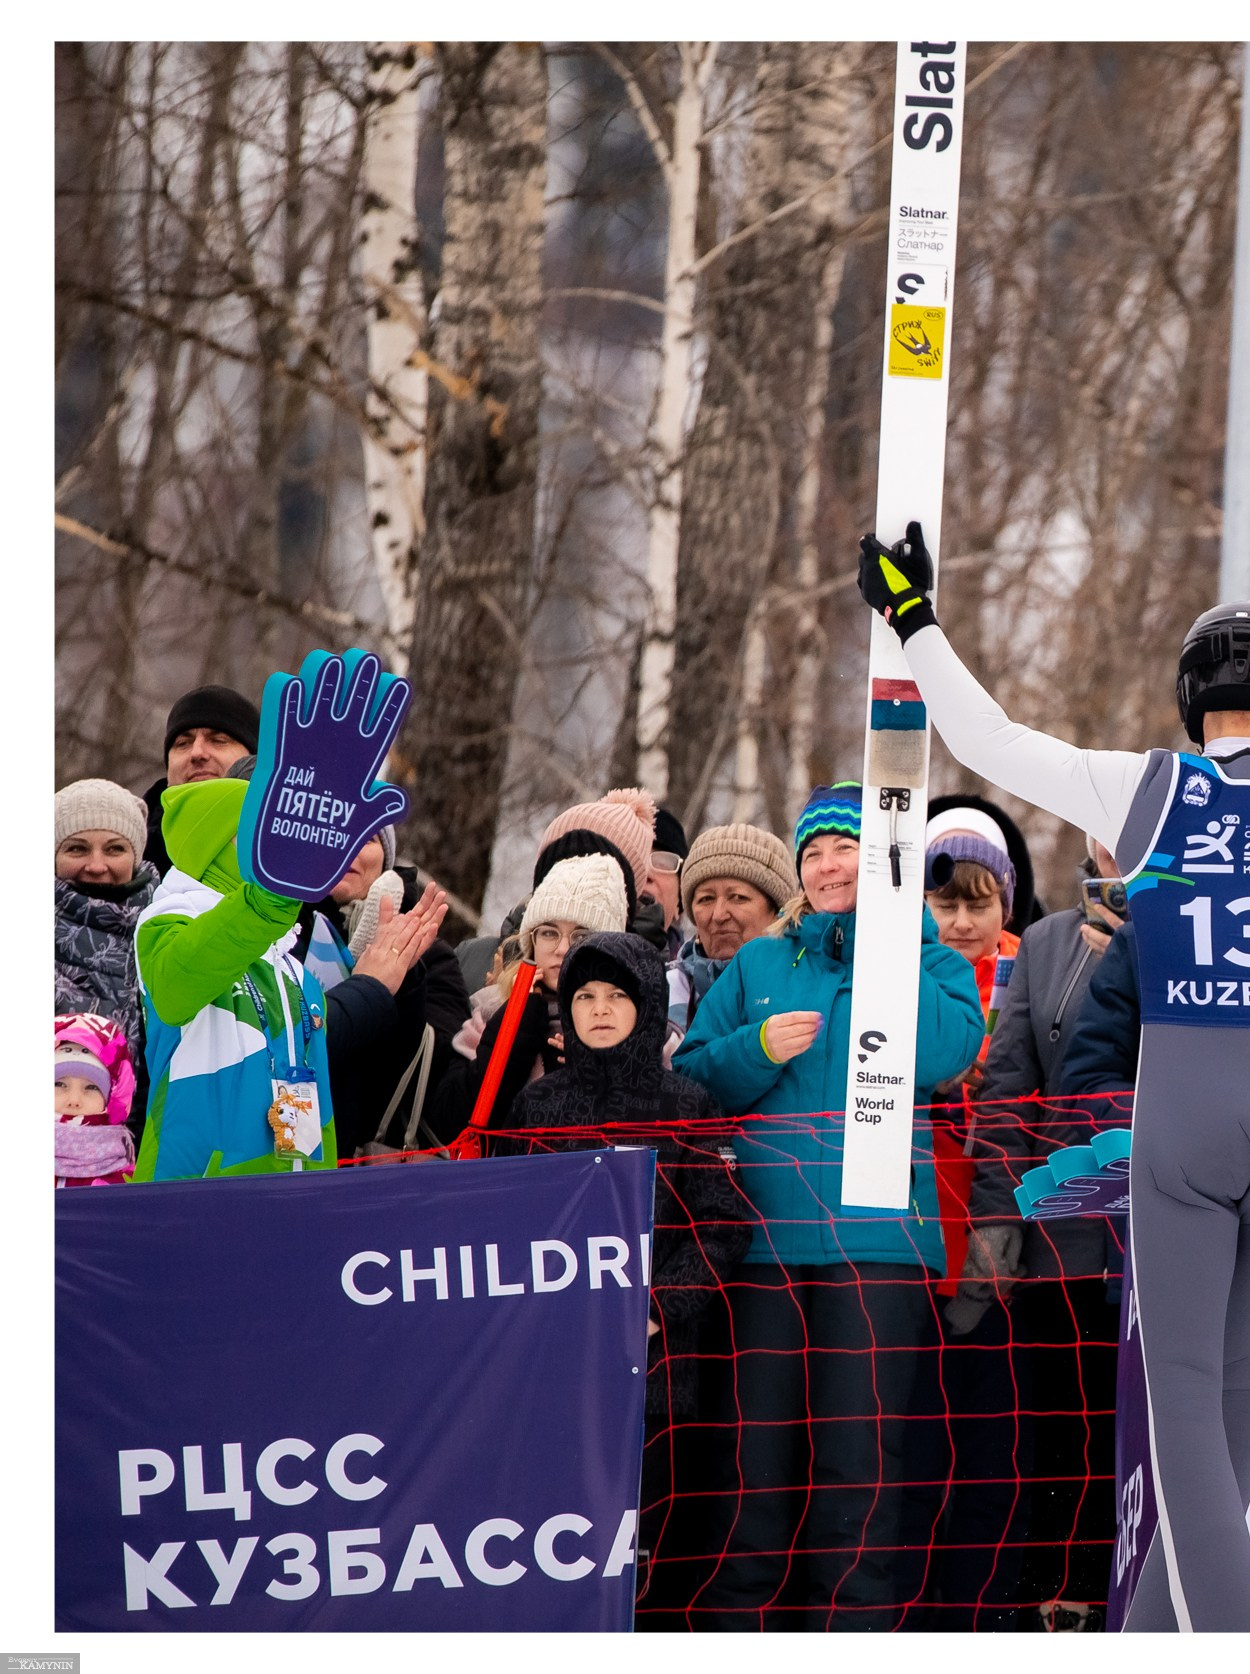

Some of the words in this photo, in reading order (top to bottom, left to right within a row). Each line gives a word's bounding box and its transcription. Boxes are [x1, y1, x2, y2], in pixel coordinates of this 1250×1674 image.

[899, 206, 947, 220] Slatnar
[898, 228, 948, 239] スラットナー
[897, 238, 944, 252] Слатнар
[892, 319, 923, 338] СТРИЖ
[284, 766, 315, 788] ДАЙ
[276, 787, 356, 828] ПЯТЁРУ
[271, 816, 350, 850] ВОЛОНТЁРУ
[856, 1071, 904, 1085] Slatnar
[855, 1097, 894, 1111] World
[854, 1111, 882, 1125] Cup
[340, 1233, 650, 1306] CHILDR
[117, 1433, 388, 1521] РЦСС
